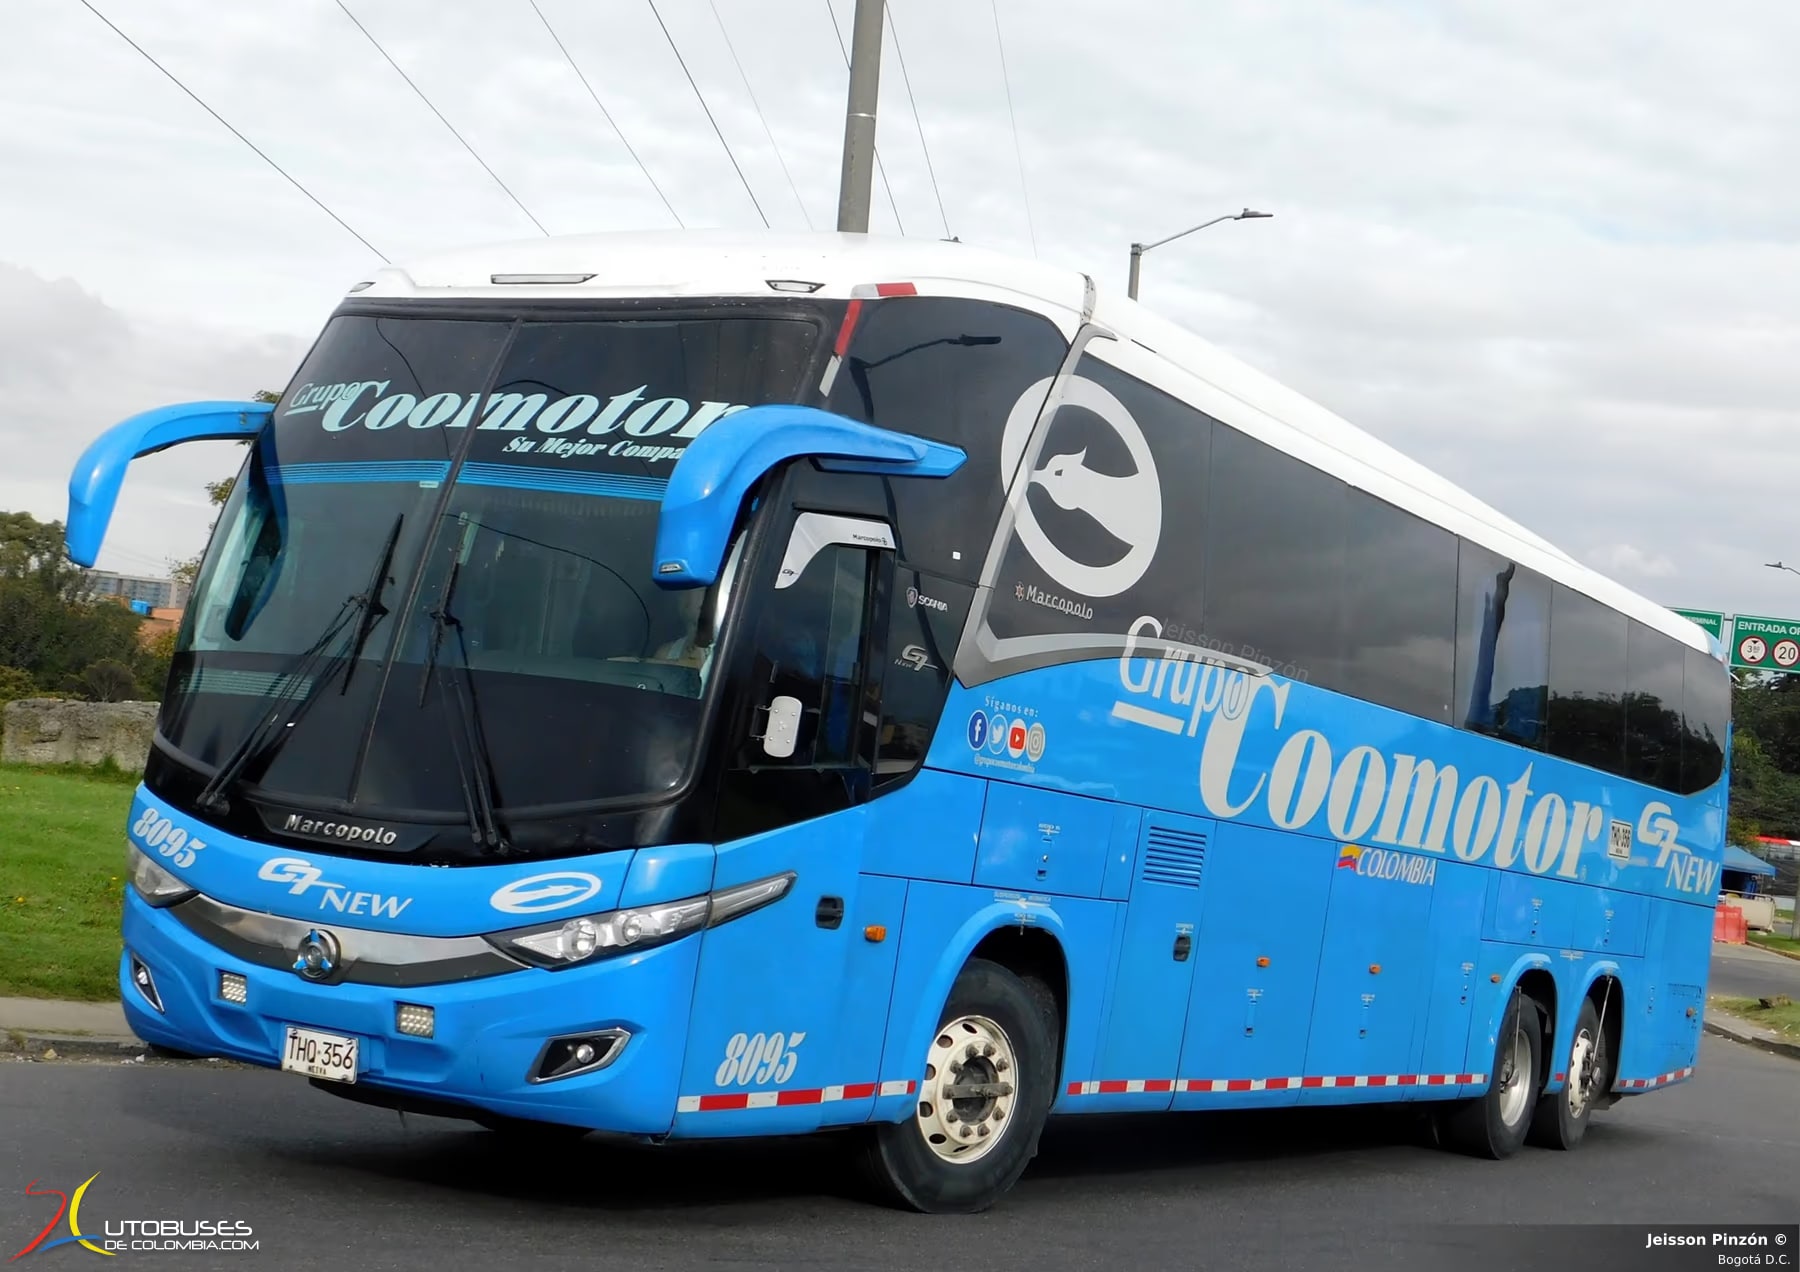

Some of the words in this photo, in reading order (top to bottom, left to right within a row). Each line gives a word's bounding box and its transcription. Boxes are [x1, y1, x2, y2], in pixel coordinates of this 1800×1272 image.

[289, 380, 358, 411] Grupo
[321, 379, 752, 438] Coomotor
[502, 436, 537, 453] Su
[535, 437, 608, 459] Mejor
[917, 594, 948, 613] SCANIA
[1026, 584, 1094, 620] Marcopolo
[1737, 620, 1788, 635] ENTRADA
[1778, 646, 1797, 660] 20
[1023, 707, 1039, 717] en:
[1119, 615, 1251, 738] Grupo
[1200, 674, 1603, 879] Coomotor
[132, 807, 207, 869] 8095
[284, 813, 397, 845] Marcopolo
[258, 857, 346, 895] G7
[1356, 846, 1438, 886] COLOMBIA
[1665, 852, 1720, 895] NEW
[319, 887, 414, 918] NEW
[714, 1032, 807, 1087] 8095
